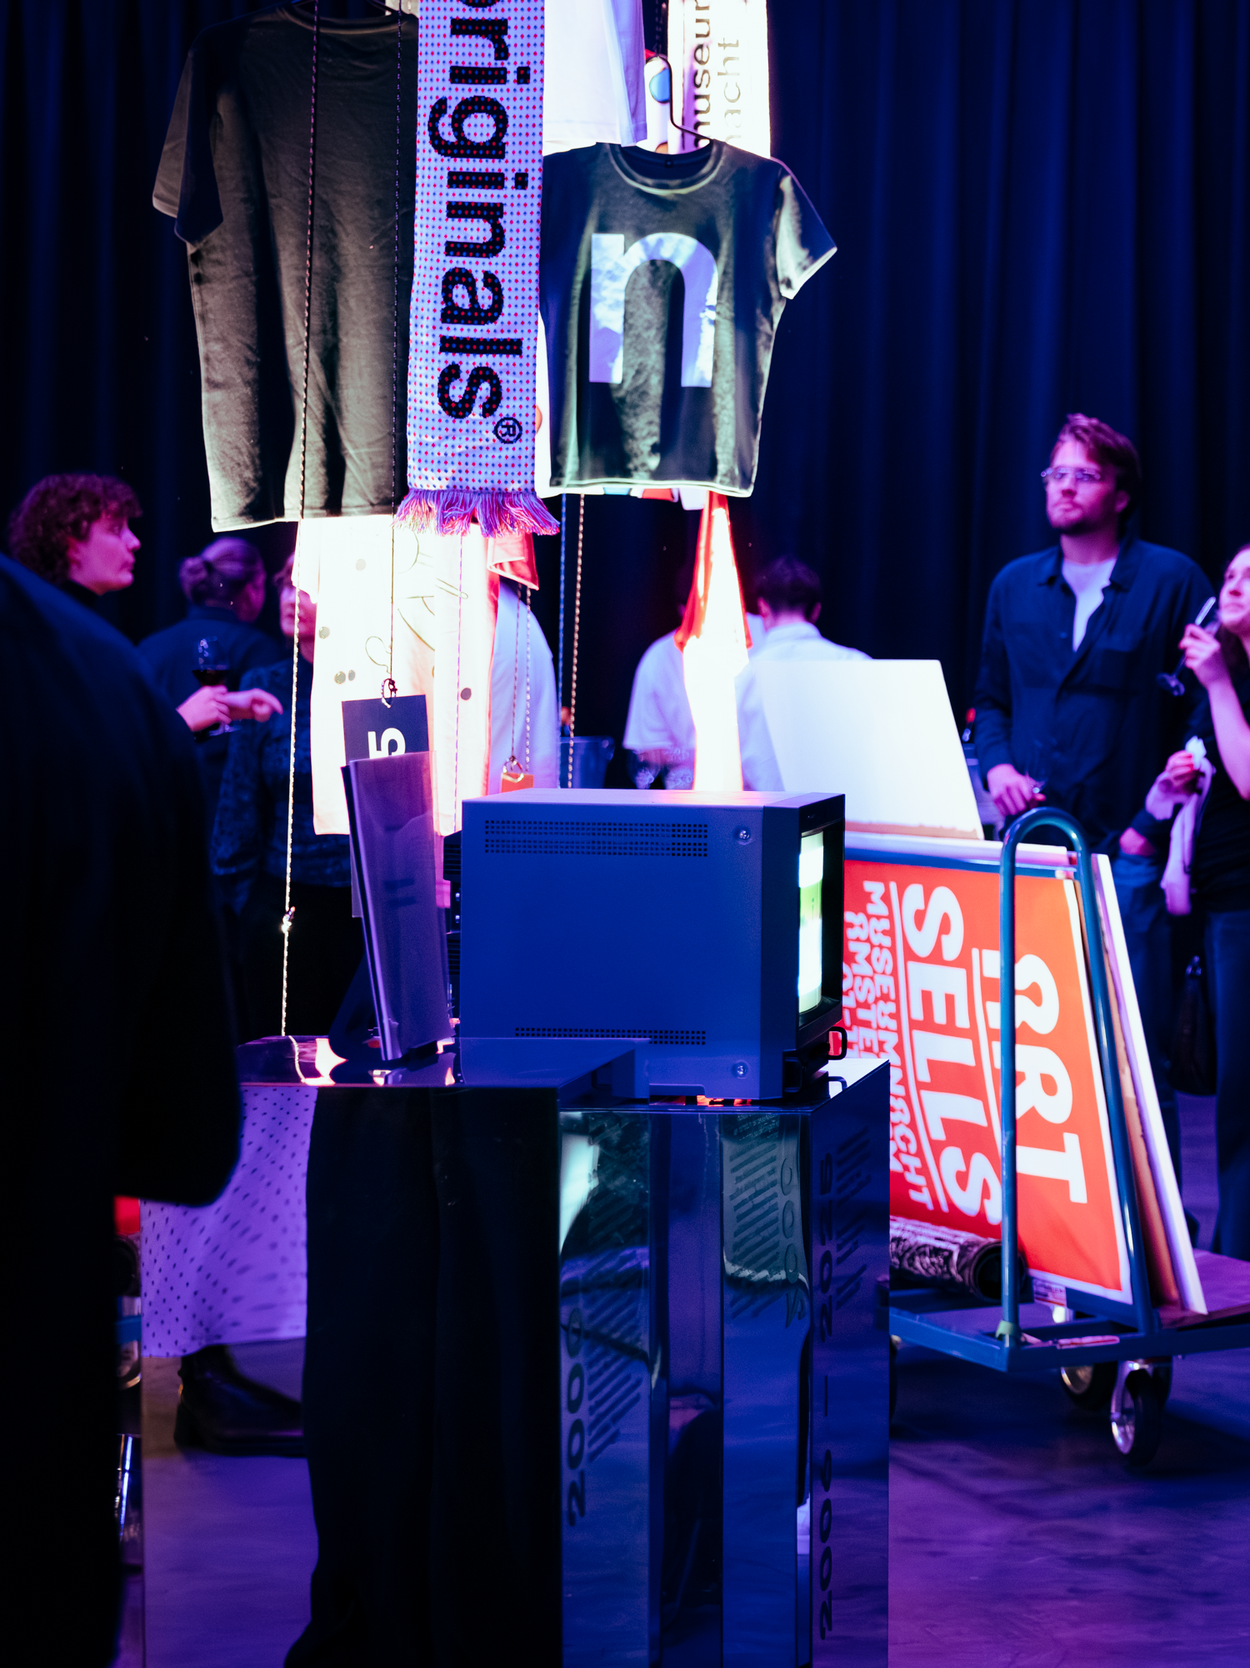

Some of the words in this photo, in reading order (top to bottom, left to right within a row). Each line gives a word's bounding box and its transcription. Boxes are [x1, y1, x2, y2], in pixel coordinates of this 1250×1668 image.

[588, 231, 719, 388] n
[901, 883, 1002, 1226] SELLS
[982, 948, 1088, 1204] ART
[817, 1151, 834, 1343] 2025
[817, 1449, 834, 1641] 2006
